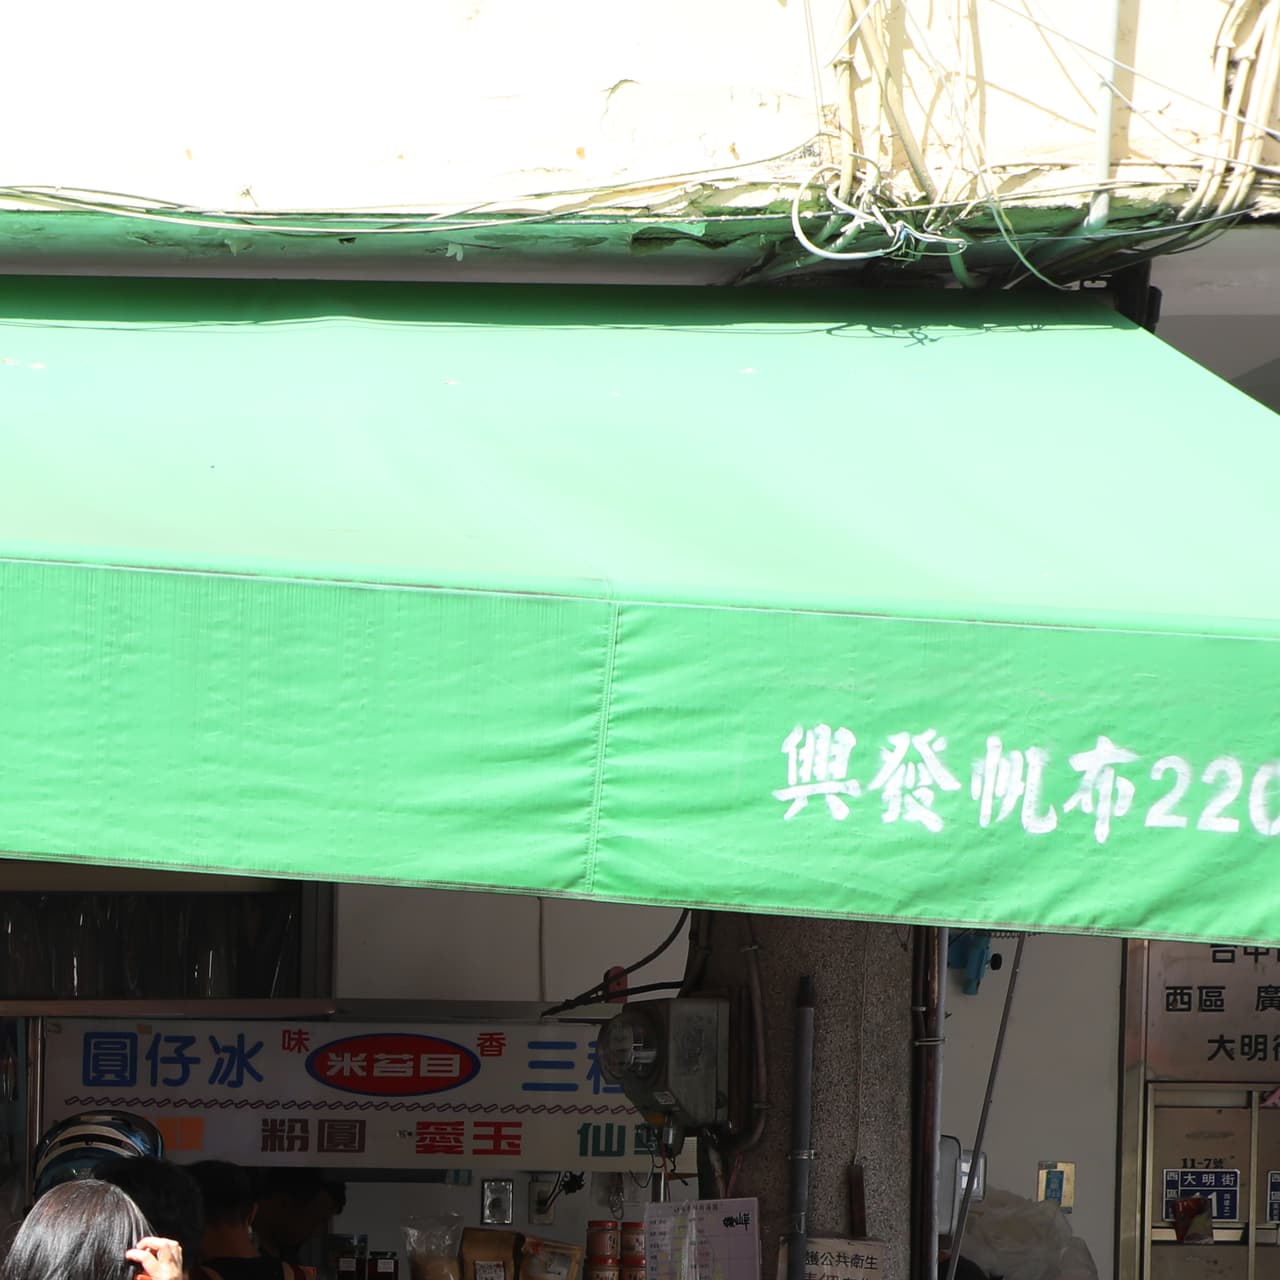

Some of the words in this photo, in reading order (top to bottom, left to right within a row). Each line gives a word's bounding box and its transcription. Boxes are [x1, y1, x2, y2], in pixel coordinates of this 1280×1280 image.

[1166, 986, 1226, 1012] 西區
[82, 1032, 264, 1088] 圓仔冰
[327, 1052, 461, 1079] 米苔目
[261, 1119, 366, 1153] 粉圓
[416, 1120, 522, 1155] 愛玉
[1184, 1173, 1235, 1186] 大明街
